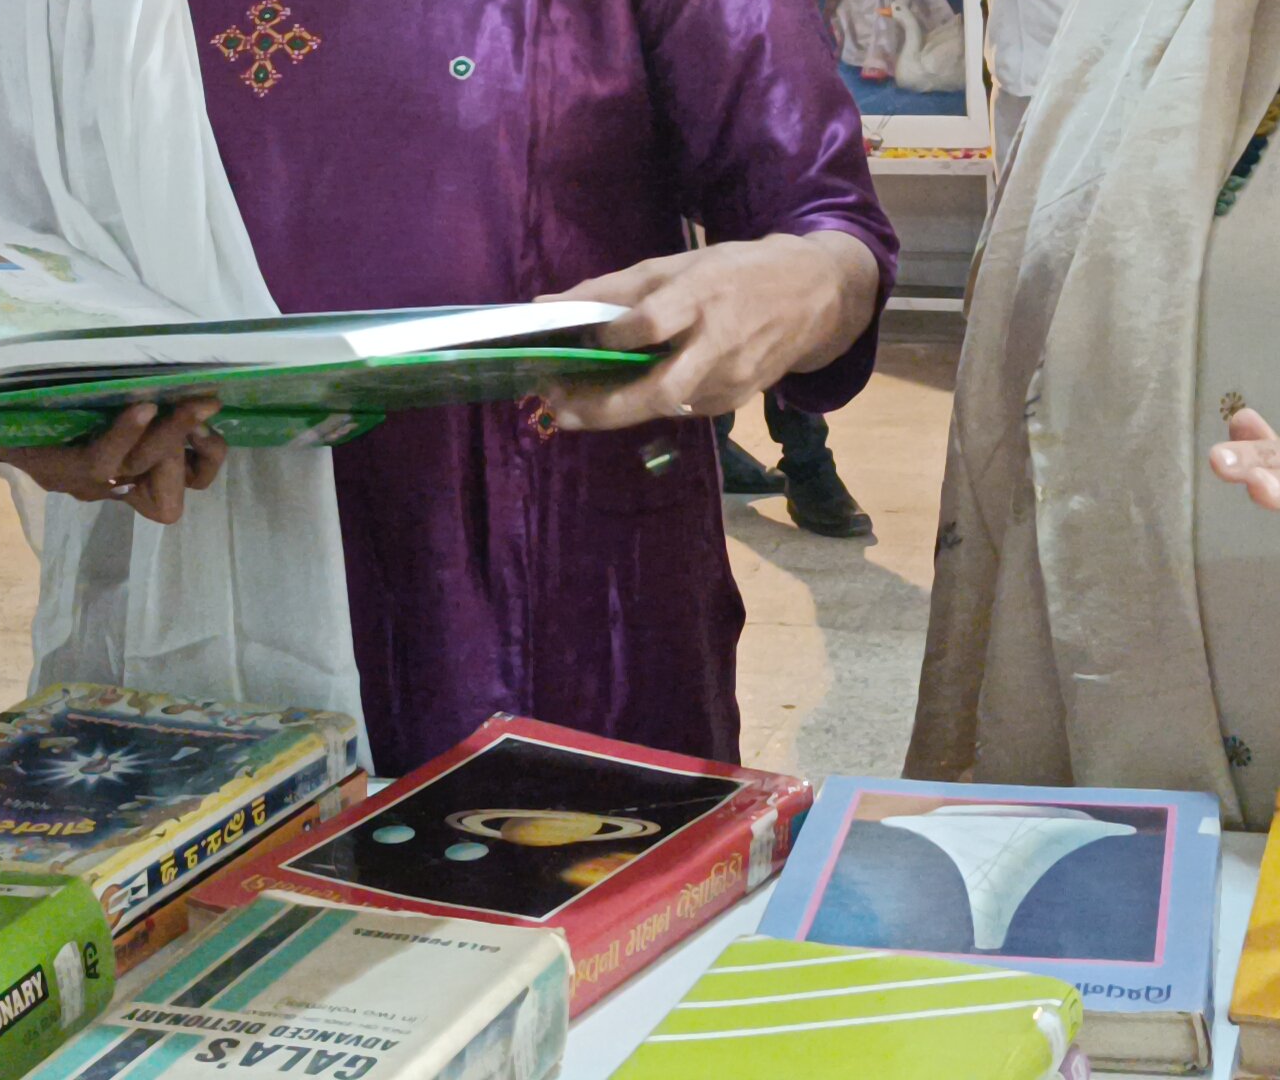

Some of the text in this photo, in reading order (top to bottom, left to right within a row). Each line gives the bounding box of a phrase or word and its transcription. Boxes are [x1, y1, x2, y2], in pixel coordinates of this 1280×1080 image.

[352, 927, 501, 954] GALA PUBLISHERS
[625, 905, 671, 956] મહાન
[122, 1008, 401, 1051] ADVANCED DICTIONARY
[195, 1037, 378, 1080] GALA'S
